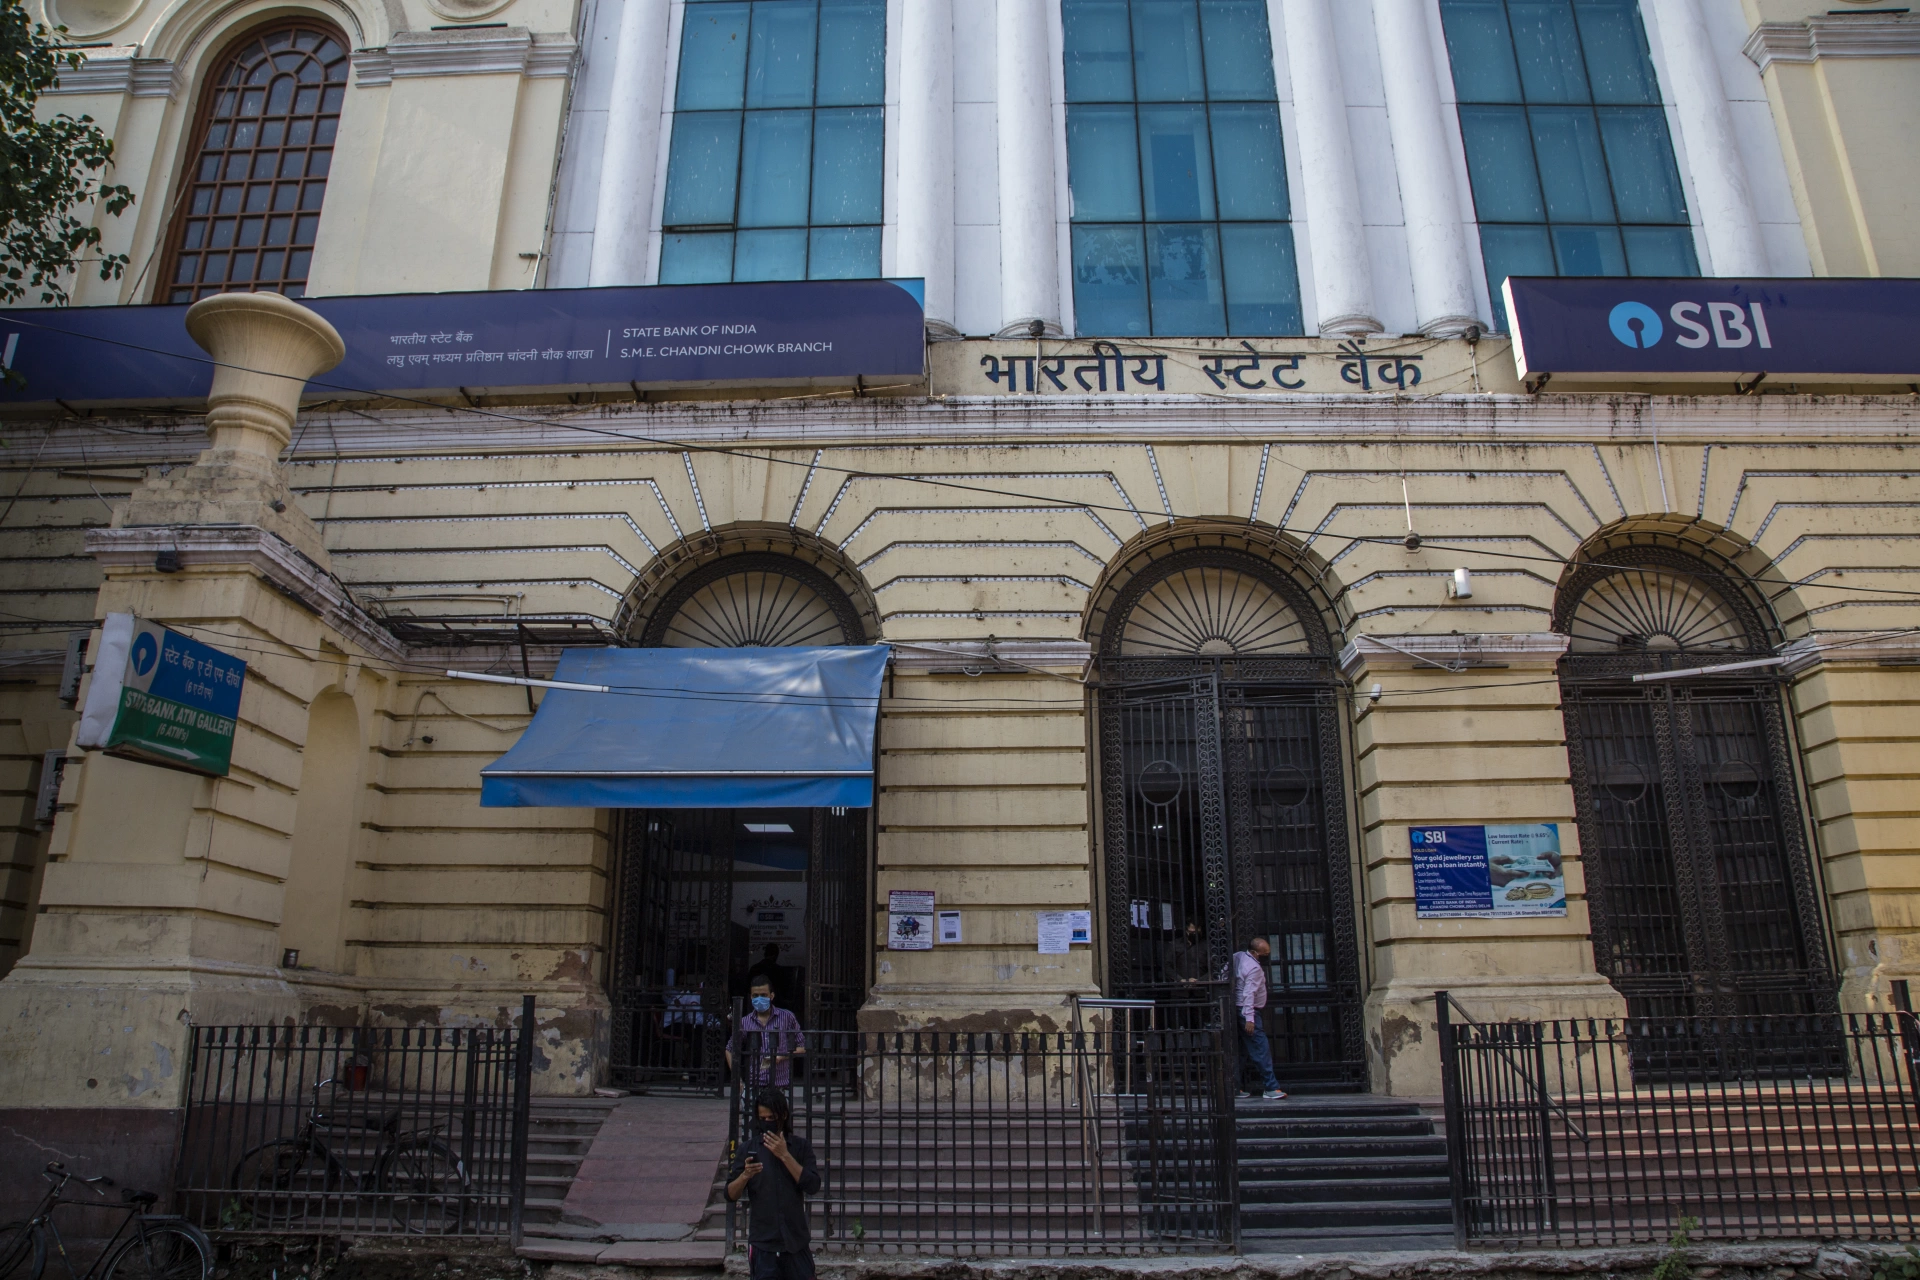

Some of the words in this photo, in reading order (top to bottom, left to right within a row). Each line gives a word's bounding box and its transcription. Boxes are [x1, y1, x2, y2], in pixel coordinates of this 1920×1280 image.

[623, 328, 660, 338] STATE
[664, 326, 698, 336] BANK
[701, 326, 719, 335] OF
[721, 325, 756, 334] INDIA
[1670, 301, 1772, 348] SBI
[390, 332, 427, 345] भारतीय
[430, 331, 452, 343] स्टेट
[455, 330, 473, 342] बैंक
[387, 354, 405, 367] लघु
[408, 354, 429, 366] एवम्
[432, 353, 461, 363] मध्यम
[465, 350, 503, 362] प्रतिष्ठान
[507, 349, 538, 361] चांदनी
[541, 348, 563, 360] चौक
[566, 350, 594, 359] शाखा
[620, 348, 656, 358] S.M.E.
[660, 345, 720, 357] CHANDNI
[724, 344, 774, 355] CHOWK
[777, 342, 832, 353] BRANCH
[980, 340, 1167, 391] भारतीय
[1199, 341, 1306, 390] स्टेट
[1336, 339, 1423, 391] बैंक
[165, 644, 180, 665] स्टेट
[147, 697, 177, 721] BANK
[176, 708, 197, 727] ATM
[197, 713, 234, 737] GALLERY
[1424, 831, 1446, 843] SBI
